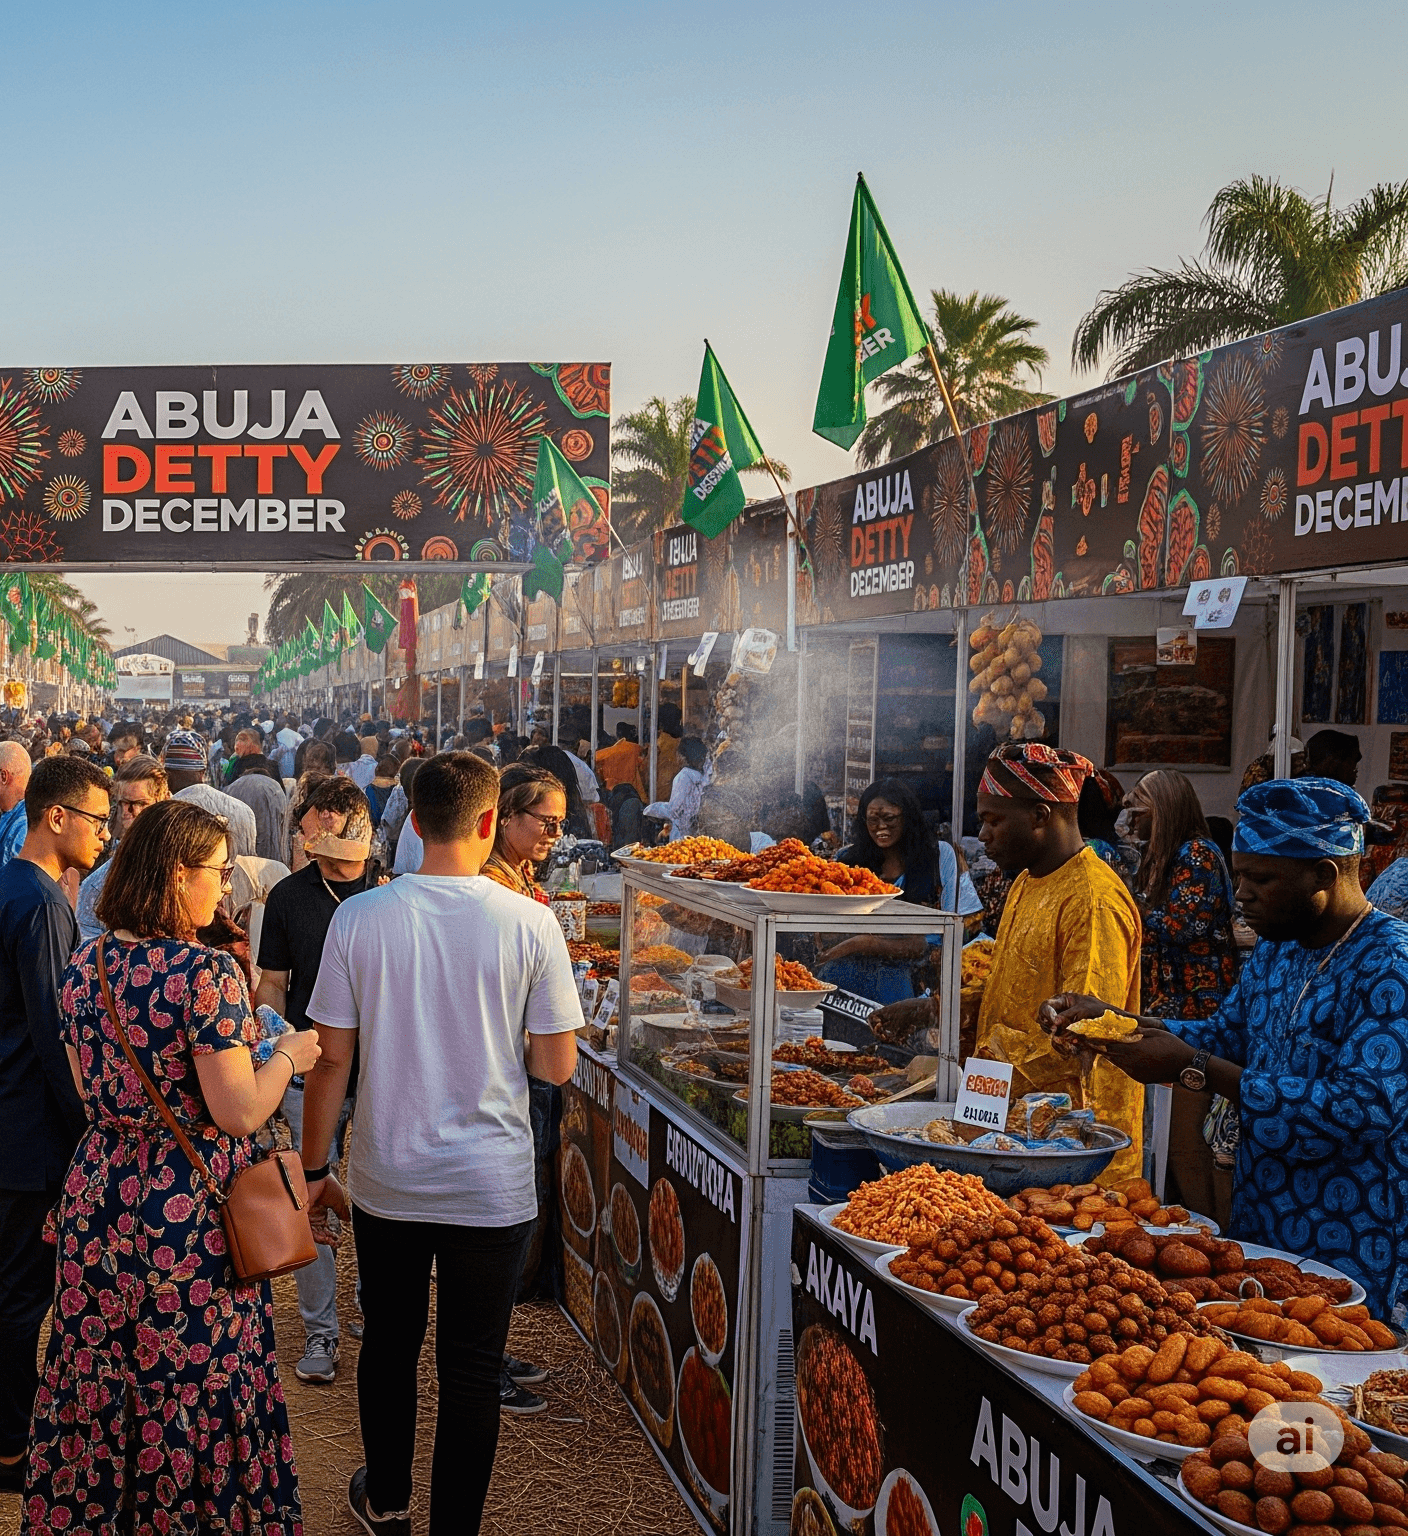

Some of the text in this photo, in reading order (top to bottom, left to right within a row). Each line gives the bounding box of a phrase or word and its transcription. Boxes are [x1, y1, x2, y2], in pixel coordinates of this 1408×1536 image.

[1298, 322, 1408, 415] ABU
[101, 389, 342, 441] ABUJA
[102, 443, 339, 495] DETTY
[102, 498, 346, 533] DECEMBER
[852, 469, 914, 525] ABUJA
[850, 513, 915, 568] DETTY
[850, 560, 915, 598] DECEMBER
[805, 1242, 879, 1357] AKAYA
